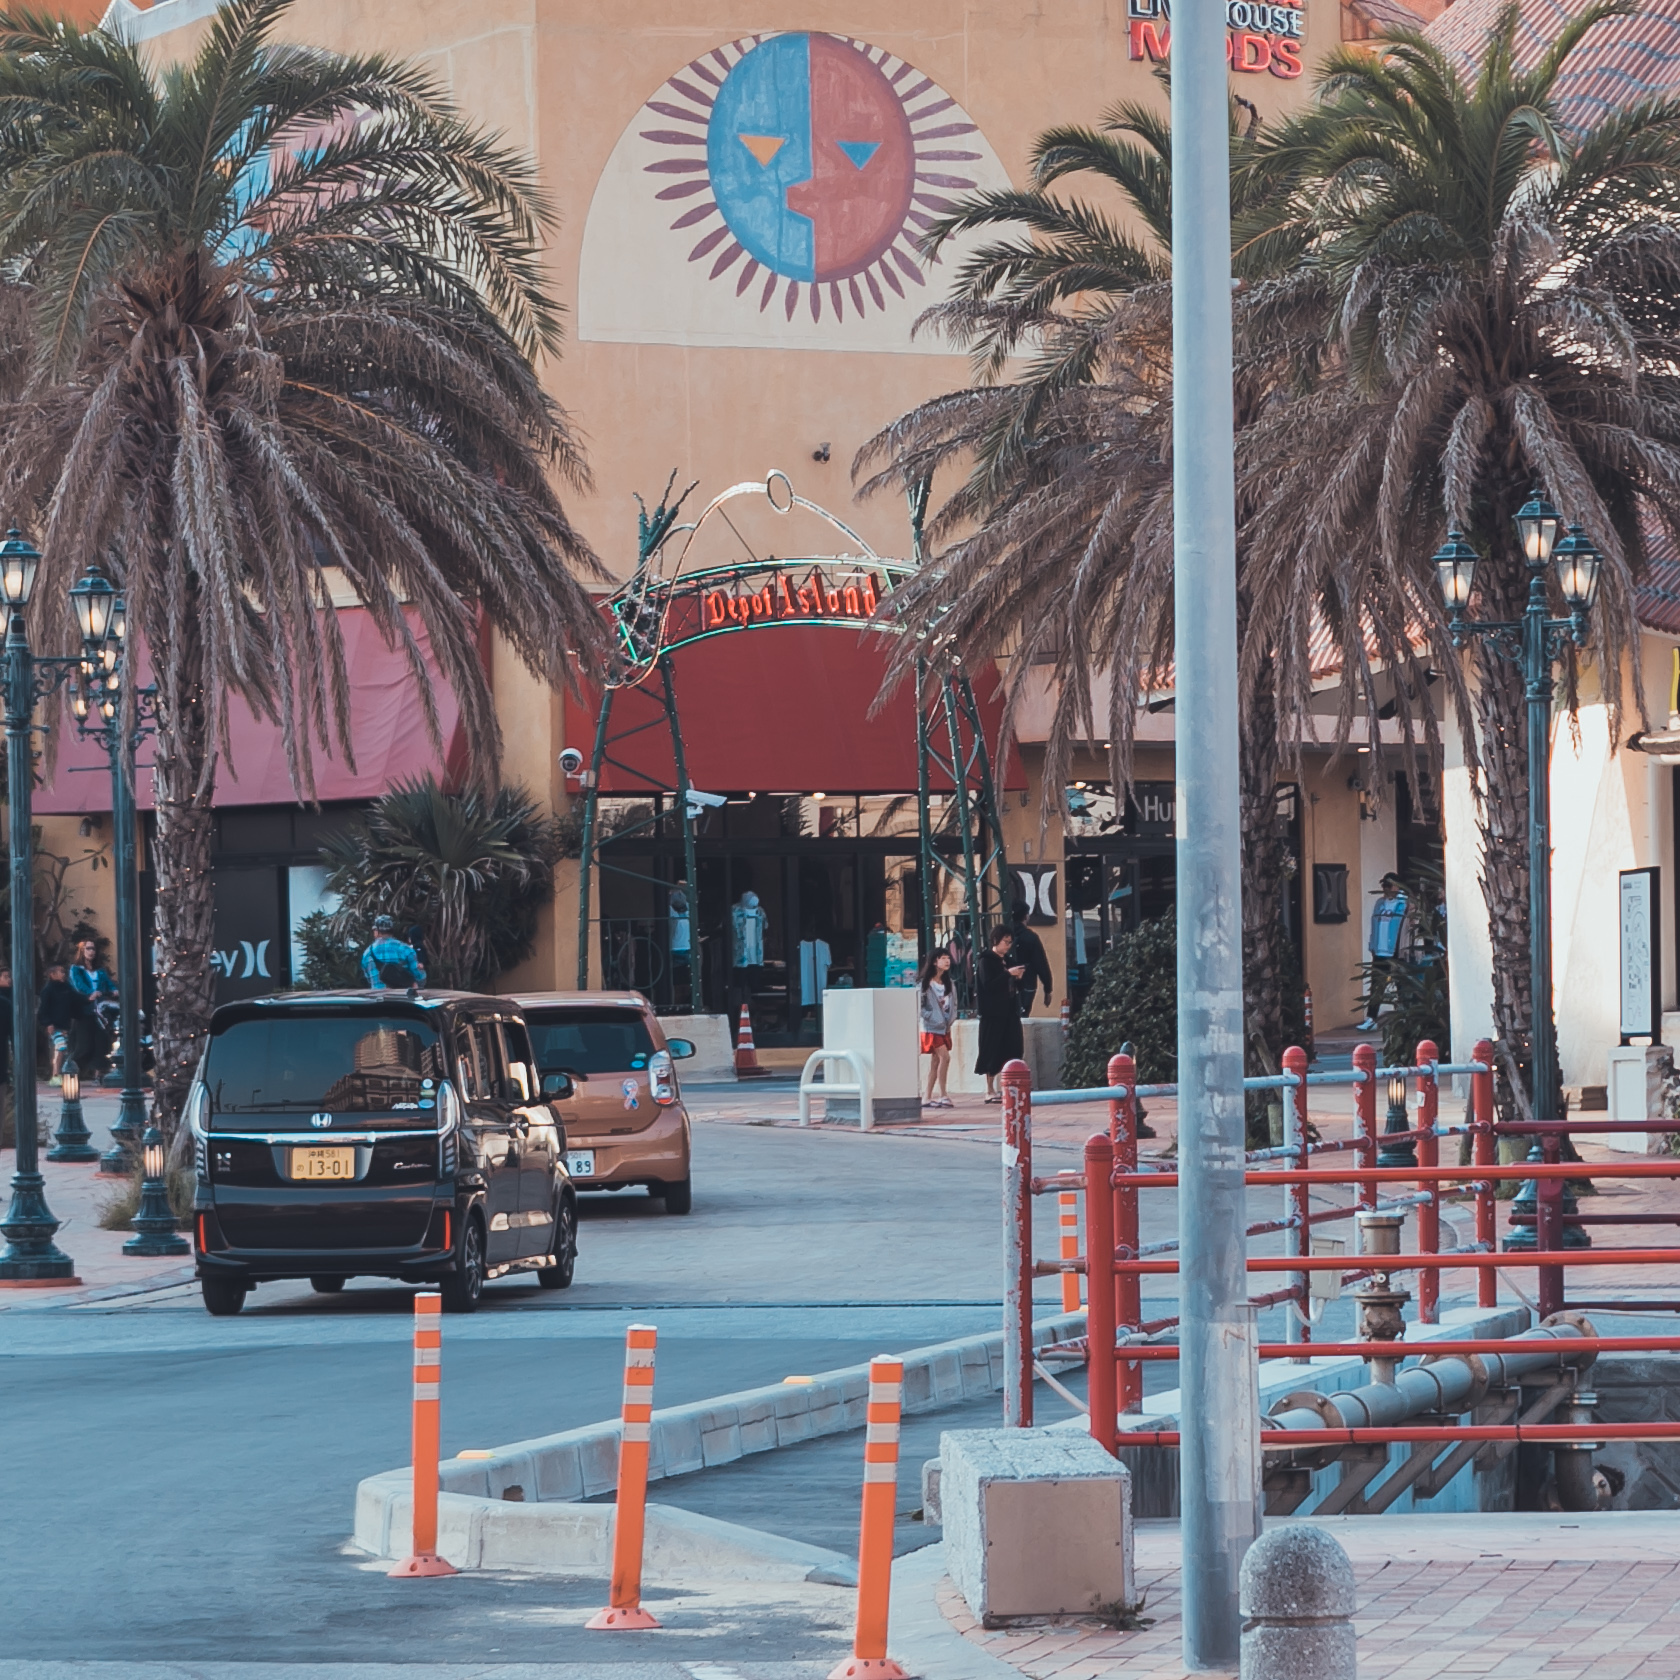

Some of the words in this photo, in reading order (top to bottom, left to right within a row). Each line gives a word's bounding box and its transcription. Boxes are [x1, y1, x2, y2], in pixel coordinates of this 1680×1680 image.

[707, 584, 774, 627] Depot
[778, 572, 881, 618] Island
[309, 1159, 349, 1176] 13-01
